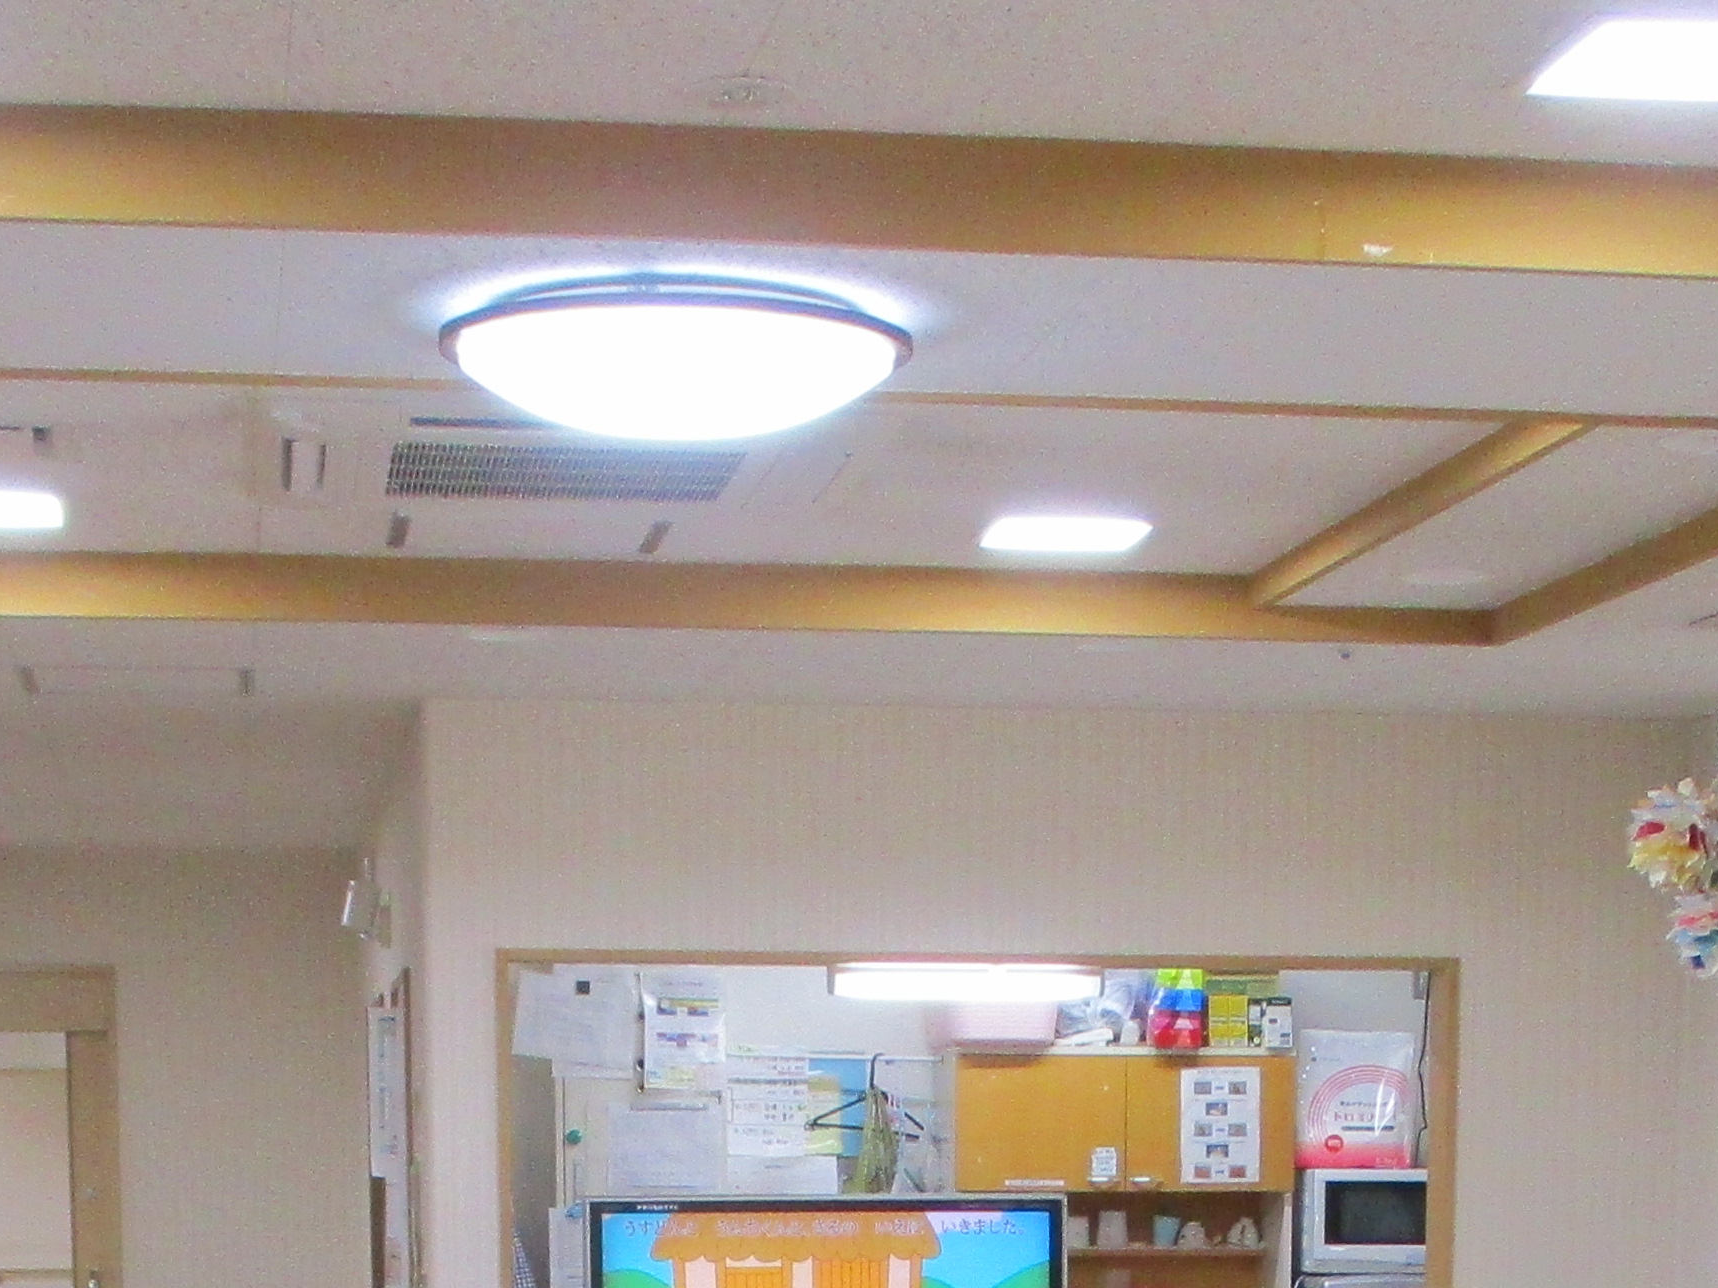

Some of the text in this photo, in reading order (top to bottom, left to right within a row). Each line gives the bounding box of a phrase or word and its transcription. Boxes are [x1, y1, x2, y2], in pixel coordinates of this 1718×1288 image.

[941, 1219, 1028, 1236] いきました。
